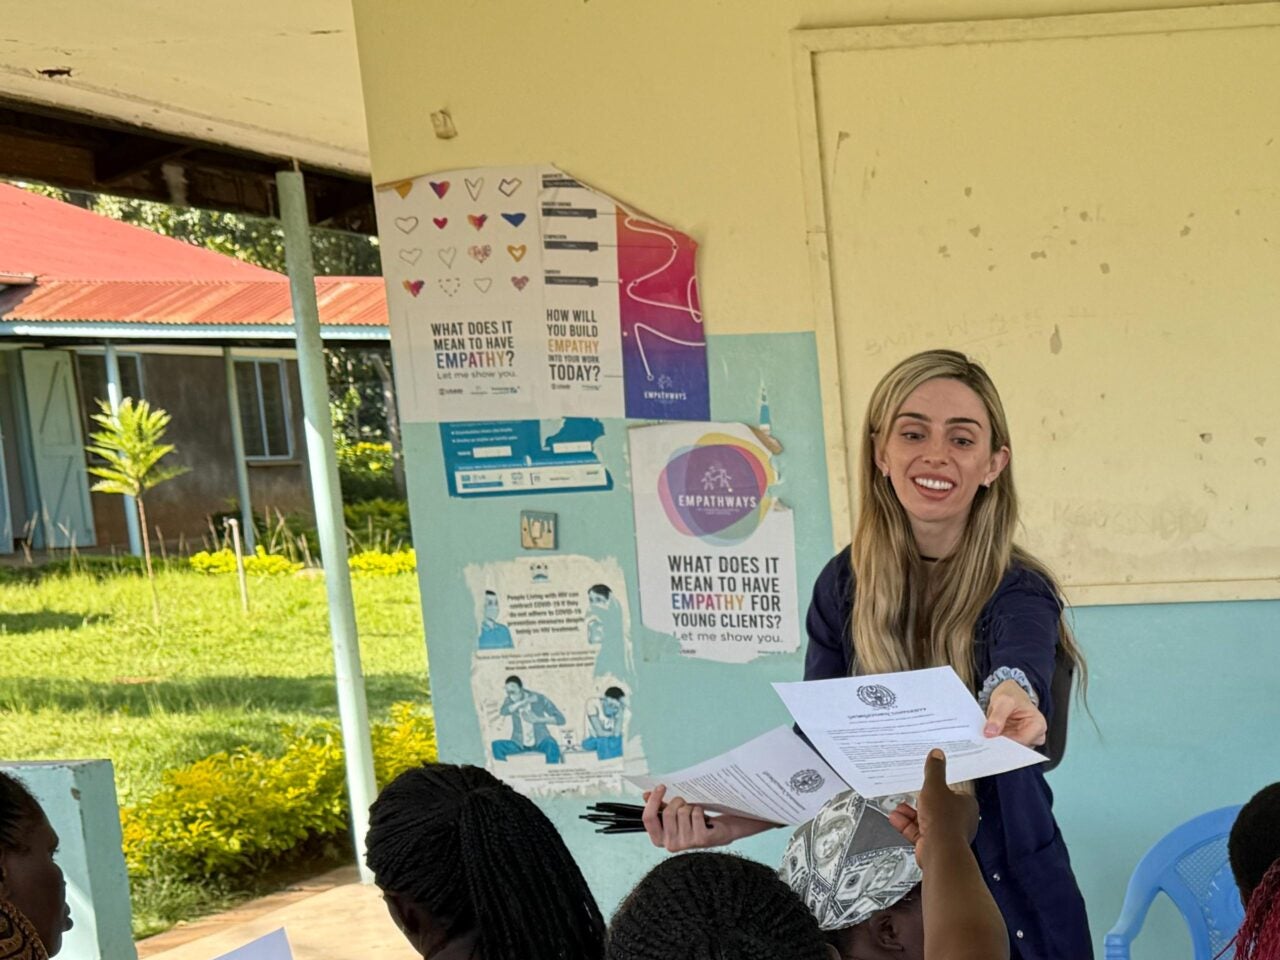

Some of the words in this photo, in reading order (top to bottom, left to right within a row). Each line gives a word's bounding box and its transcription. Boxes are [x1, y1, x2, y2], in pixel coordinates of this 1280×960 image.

[546, 309, 569, 322] HOW
[572, 310, 598, 322] WILL
[431, 322, 464, 336] WHAT
[468, 321, 498, 336] DOES
[502, 320, 513, 334] IT
[546, 324, 566, 337] YOU
[570, 325, 598, 338] BUILD
[434, 338, 465, 351] MEAN
[468, 337, 482, 350] TO
[486, 336, 514, 349] HAVE
[548, 339, 600, 353] EMPATHY
[436, 350, 515, 369] EMPATHY?
[437, 370, 452, 380] Let
[498, 372, 517, 380] you.
[549, 364, 600, 382] TODAY?
[678, 494, 758, 508] EMPATHWAYS
[668, 555, 712, 574] WHAT
[719, 556, 760, 574] DOES
[765, 557, 780, 574] IT
[671, 576, 713, 592] MEAN
[718, 576, 737, 592] TO
[742, 577, 780, 594] HAVE
[672, 594, 745, 611] EMPATHY
[752, 594, 781, 612] FOR
[672, 612, 716, 628] YOUNG
[721, 613, 782, 629] CLIENTS?
[673, 631, 693, 641] Let
[697, 632, 716, 642] me
[721, 632, 753, 642] show
[758, 634, 784, 644] you.
